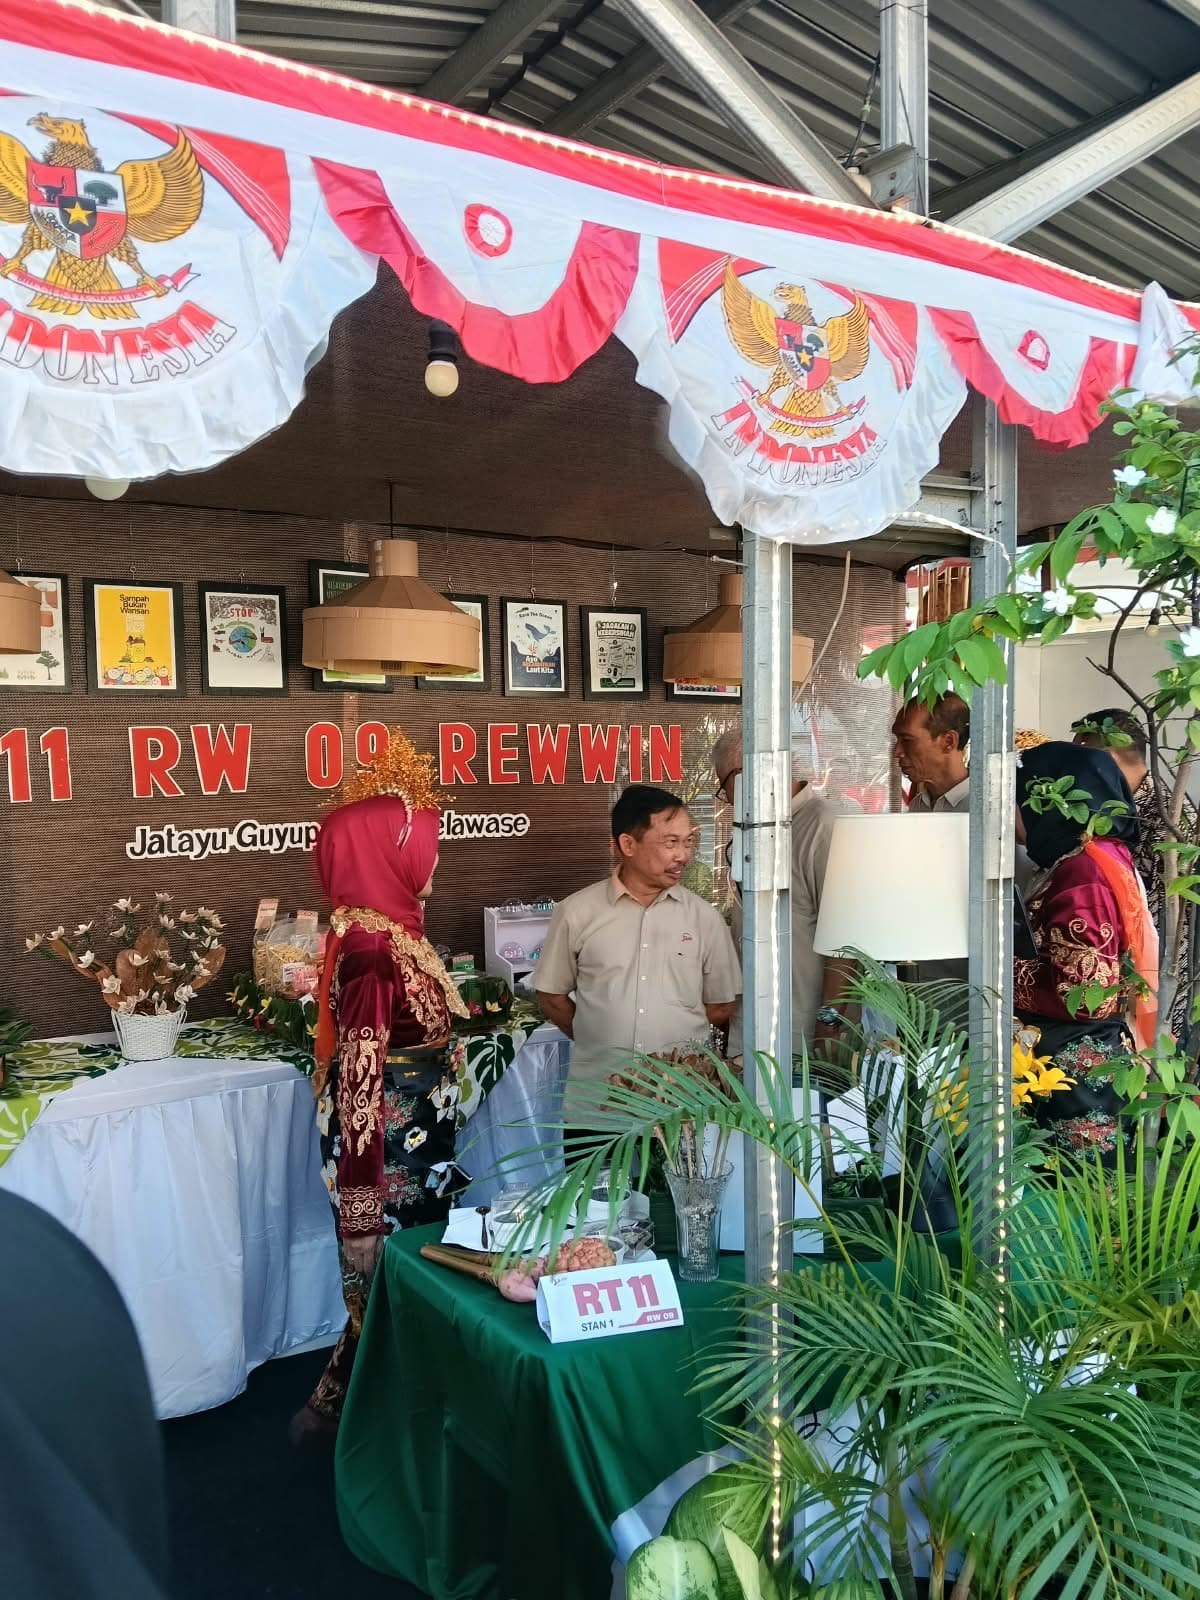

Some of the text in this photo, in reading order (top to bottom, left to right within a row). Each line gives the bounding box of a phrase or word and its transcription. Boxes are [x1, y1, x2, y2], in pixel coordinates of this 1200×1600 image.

[711, 399, 888, 486] INDONESIA
[120, 594, 150, 602] Sampah
[123, 600, 147, 608] Bukan
[230, 608, 254, 617] STOP
[0, 727, 73, 803] 11
[128, 723, 252, 799] RW
[438, 722, 683, 786] REWWIN
[126, 824, 234, 860] Jatayu
[235, 820, 319, 854] Guyup
[572, 1273, 660, 1317] RT 11
[646, 1312, 674, 1323] RW 09
[581, 1319, 615, 1332] STAN 1
